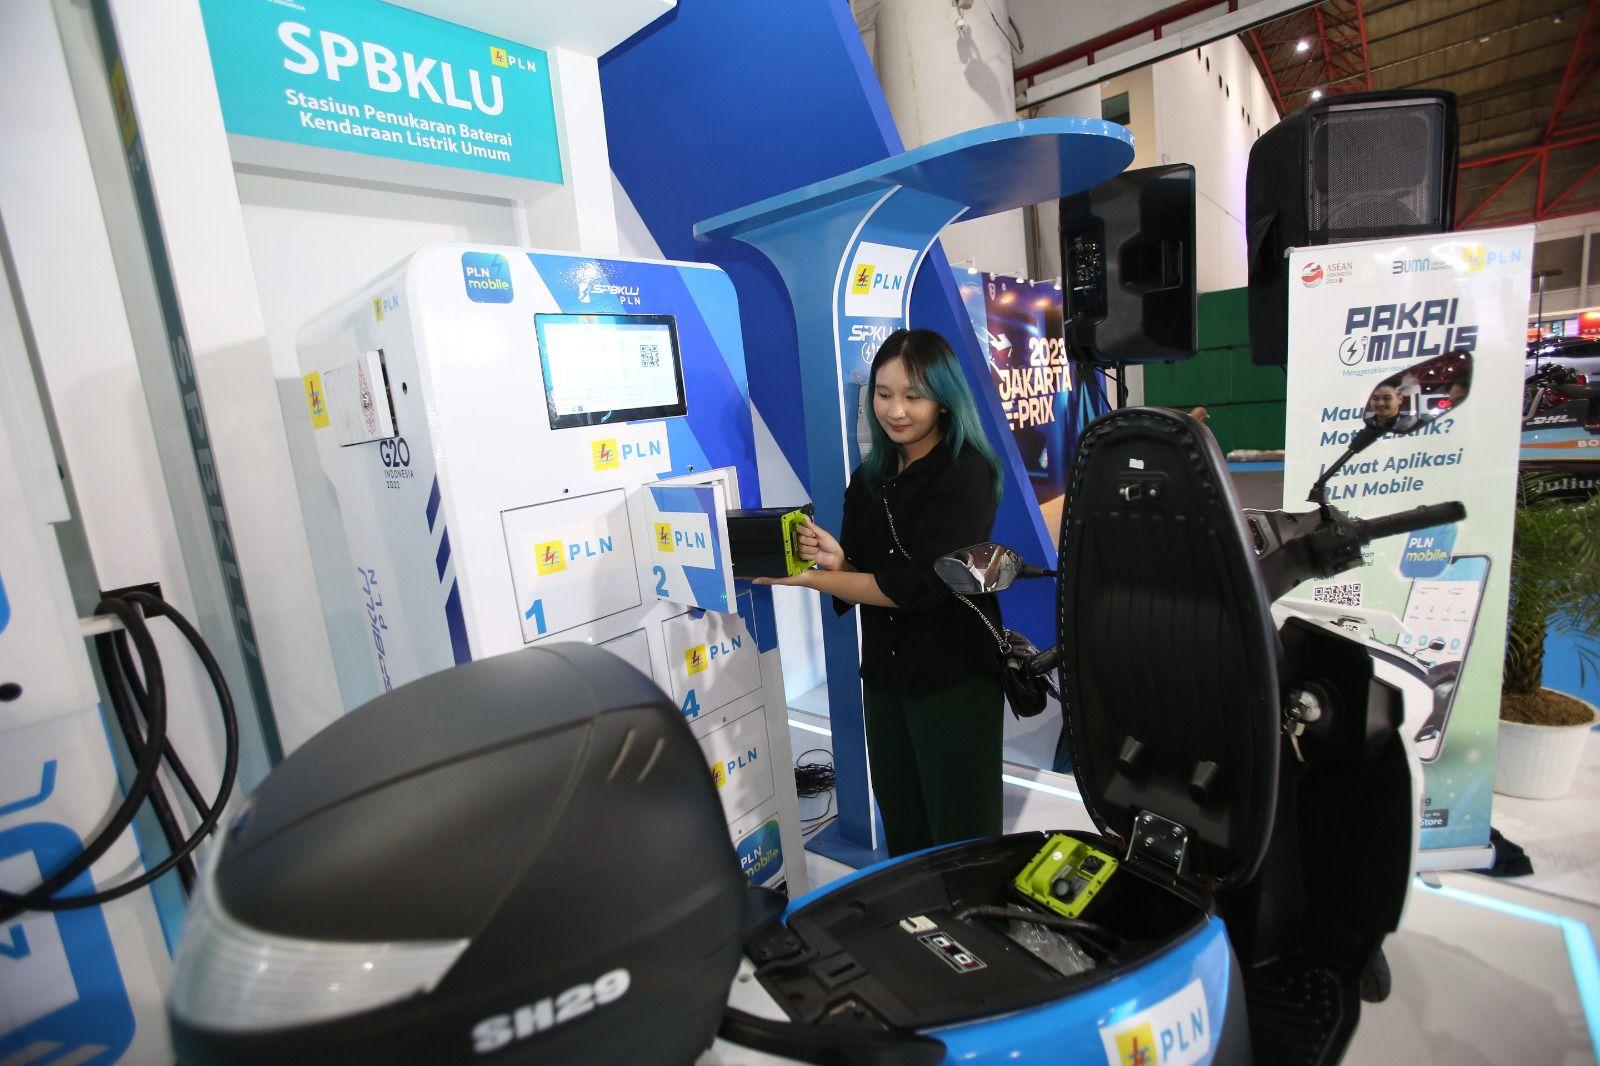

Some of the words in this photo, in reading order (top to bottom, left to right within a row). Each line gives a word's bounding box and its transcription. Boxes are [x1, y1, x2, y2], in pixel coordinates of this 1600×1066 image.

[277, 20, 504, 117] SPBKLU
[508, 55, 536, 73] PLN
[285, 88, 360, 118] Stasiun
[364, 104, 455, 136] Penukaran
[459, 123, 513, 147] Baterai
[300, 110, 403, 143] Kendaraan
[407, 132, 458, 153] Listrik
[461, 141, 511, 161] Umum
[1326, 262, 1353, 272] ASEAN
[1486, 249, 1522, 265] PLN
[466, 267, 490, 279] PLN
[469, 279, 509, 291] mobile
[872, 272, 902, 290] PLN
[383, 295, 399, 313] PLN
[620, 296, 641, 306] PLN
[1344, 298, 1459, 336] PAKAI
[1029, 336, 1068, 367] 2023
[1366, 325, 1479, 363] MOLIS
[999, 365, 1073, 401] JAKARTA
[1321, 406, 1364, 422] Mau
[380, 437, 410, 468] G20
[621, 440, 661, 460] PLN
[1383, 448, 1464, 473] Aplikasi
[384, 469, 415, 479] INDONESIA
[1362, 476, 1424, 497] Mobile
[569, 535, 613, 561] PLN
[674, 530, 706, 549] PLN
[1409, 537, 1434, 549] PLN
[1406, 549, 1447, 562] mobile
[652, 565, 669, 597] 2
[367, 569, 388, 630] PLN
[524, 598, 548, 635] 1
[709, 635, 742, 660] PLN
[681, 688, 700, 718] 4
[727, 747, 757, 774] PLN
[740, 846, 763, 869] PLN
[1160, 1008, 1206, 1063] PLN
